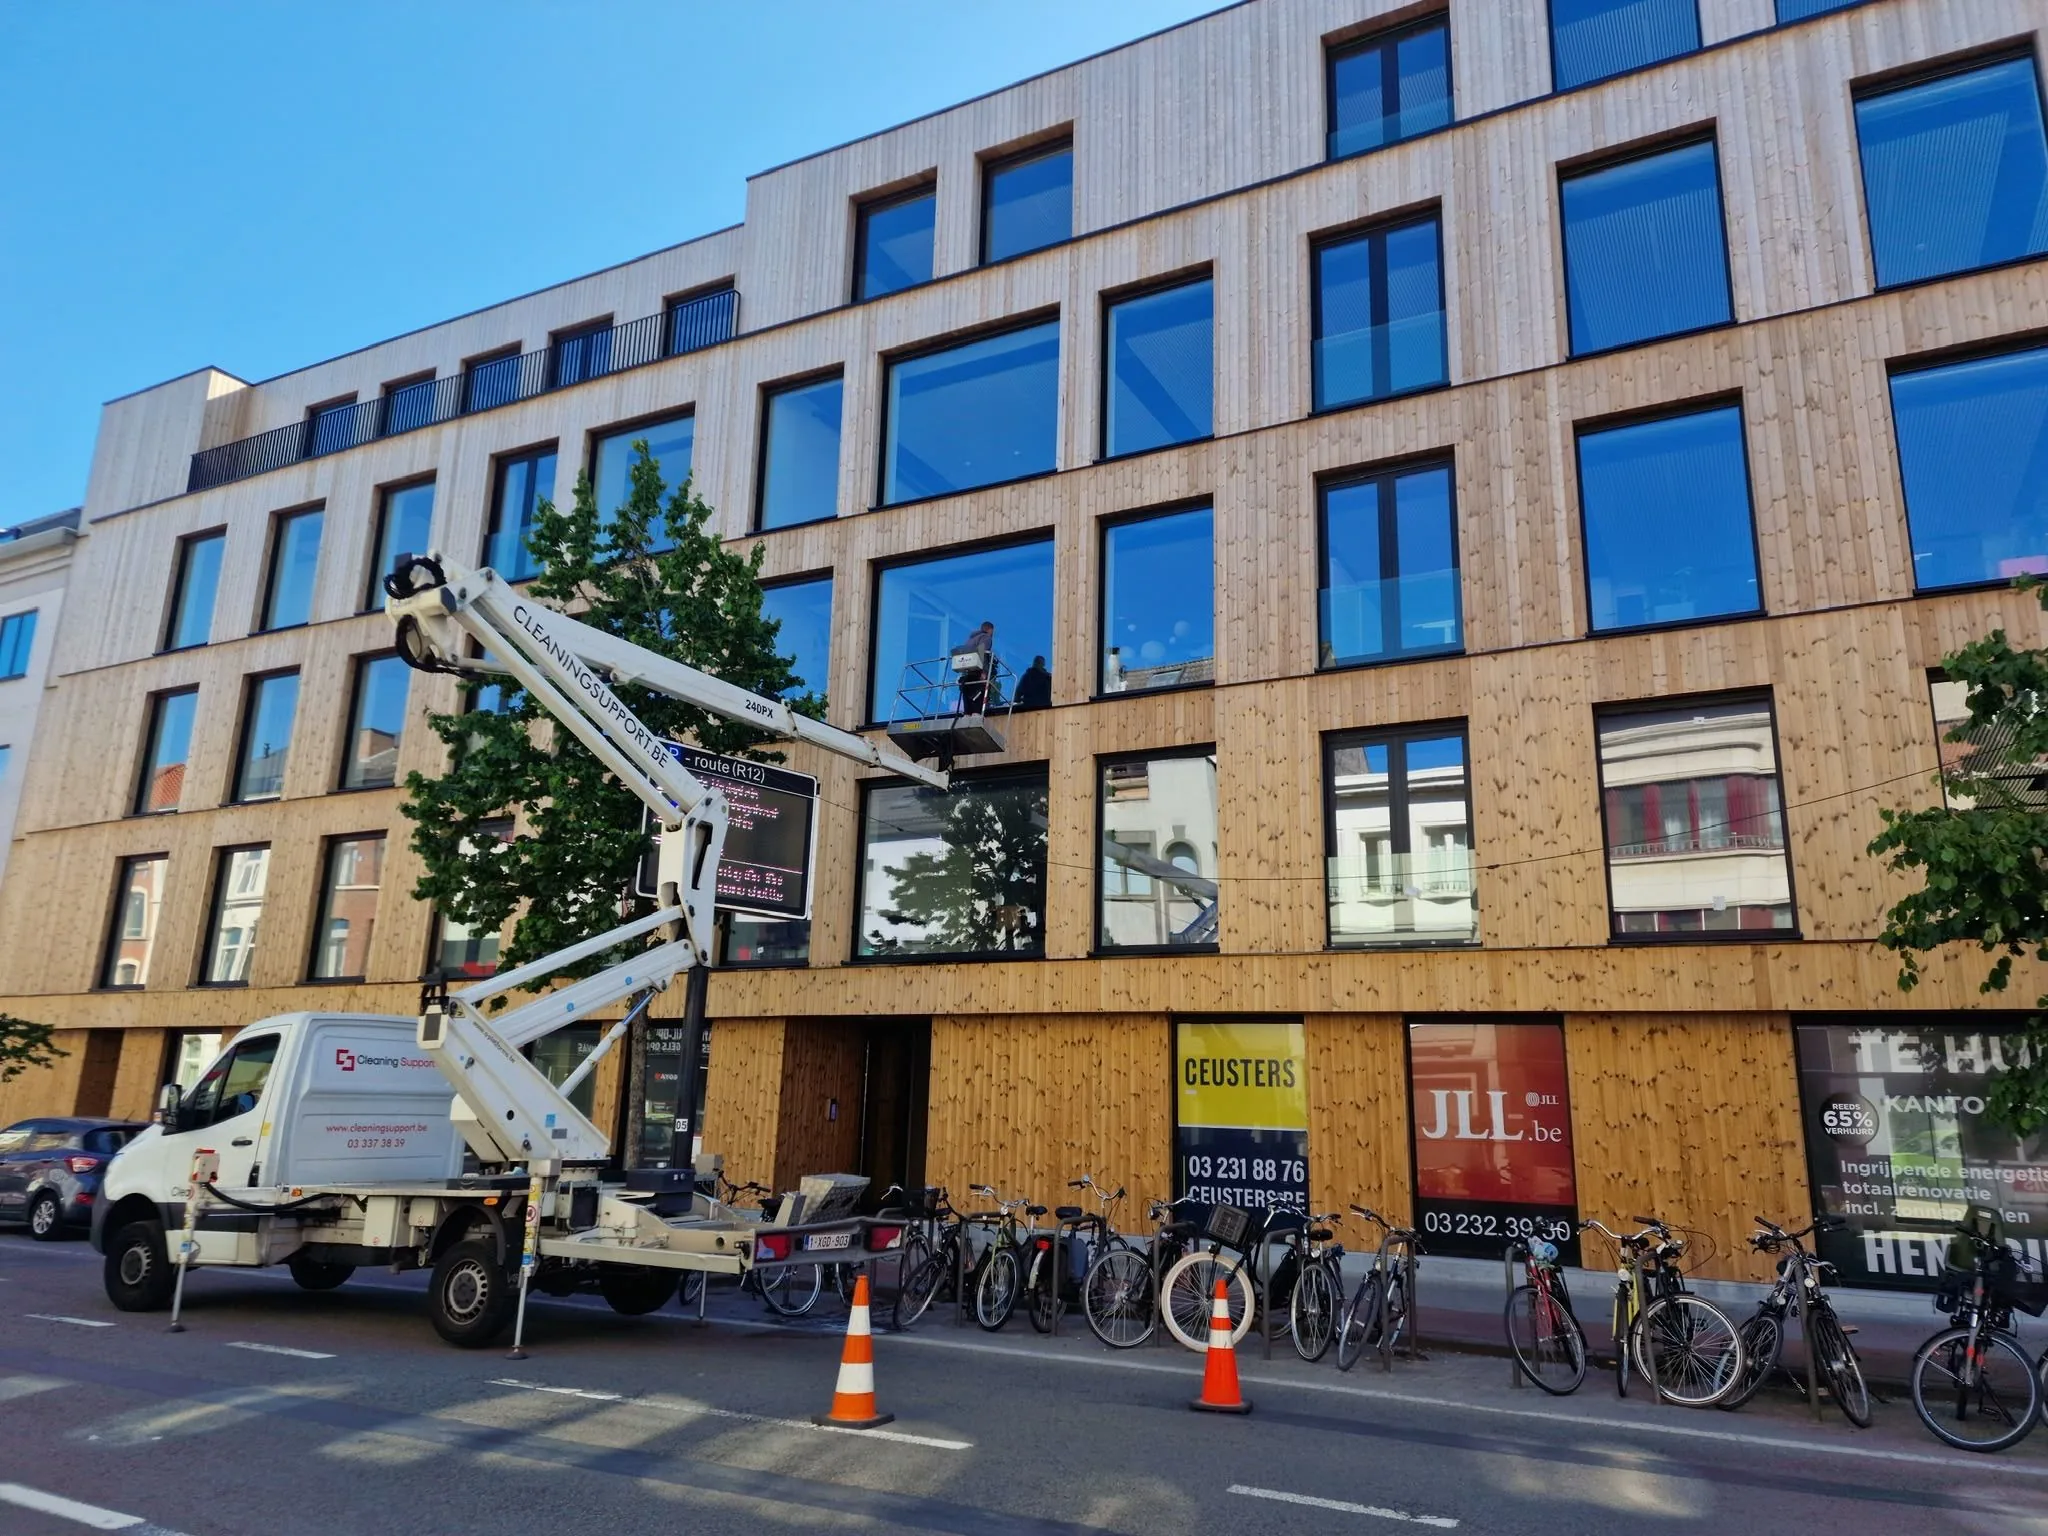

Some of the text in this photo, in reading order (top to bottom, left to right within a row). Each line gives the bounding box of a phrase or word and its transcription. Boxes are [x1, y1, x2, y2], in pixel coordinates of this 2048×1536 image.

[513, 605, 670, 769] CLEANINGSUPPORT.BE
[745, 699, 773, 719] 240PX
[694, 756, 730, 774] route
[732, 761, 766, 784] (R12)
[357, 1054, 436, 1069] Cleaning Support
[1848, 1035, 2043, 1074] TE HU
[1184, 1057, 1296, 1088] CEUSTERS
[1540, 1094, 1560, 1105] JLL
[1832, 1103, 1861, 1111] REEDS
[325, 1122, 428, 1135] www.cleaningsupport.be
[675, 1120, 688, 1131] 05
[1823, 1110, 1873, 1128] 65%
[1825, 1127, 1874, 1136] VERHUURD
[347, 1138, 406, 1149] 03 337 38 39
[1188, 1155, 1305, 1183] 03 231 88 76
[1841, 1159, 1952, 1179] Ingrijpende
[1842, 1181, 1993, 1201] totaalrenovatie
[1845, 1200, 1885, 1216] incl.
[1425, 1211, 1452, 1234] 03
